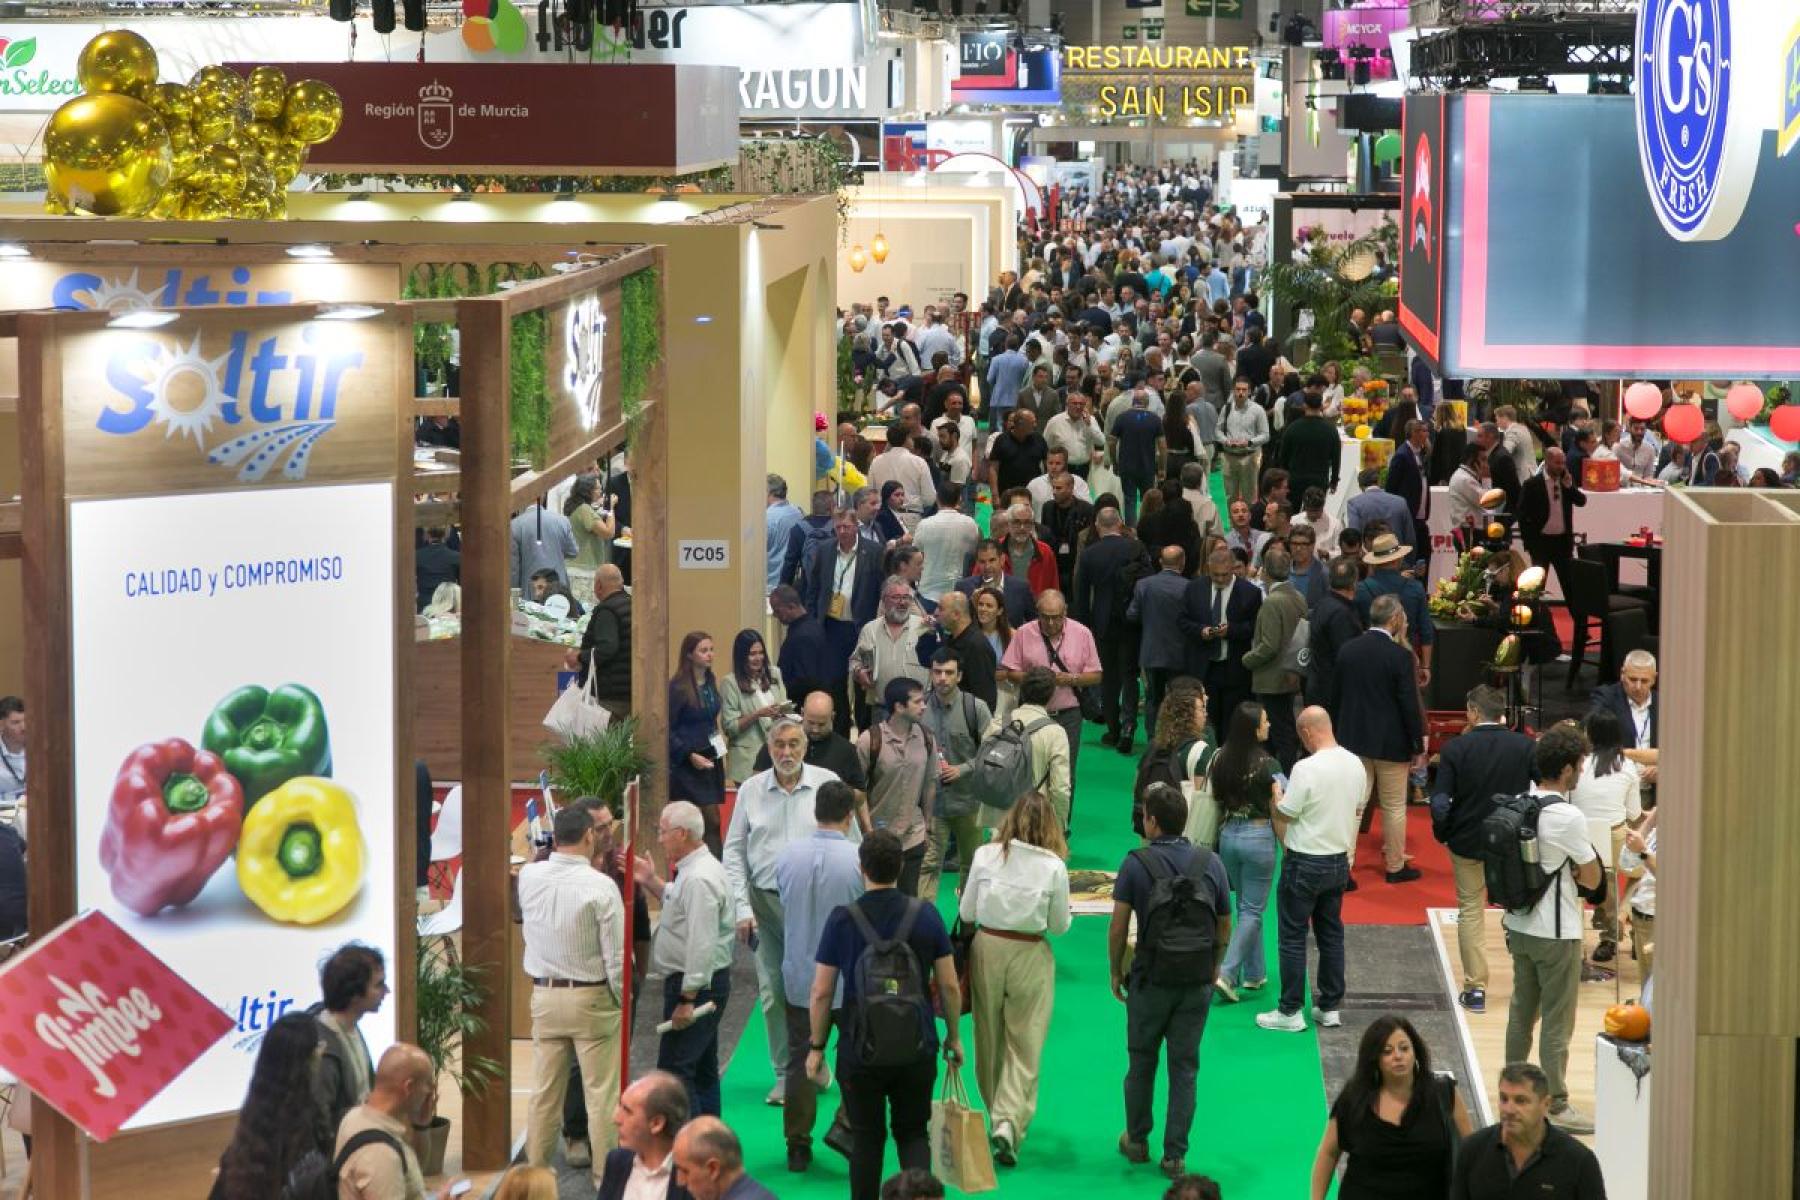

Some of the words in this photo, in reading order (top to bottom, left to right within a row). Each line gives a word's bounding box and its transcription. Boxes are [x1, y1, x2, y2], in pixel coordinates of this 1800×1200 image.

[1068, 46, 1249, 69] RESTAURANT
[1660, 1, 1711, 116] G's
[365, 103, 415, 119] Región
[458, 105, 476, 117] de
[481, 104, 529, 117] Murcia
[1101, 87, 1164, 116] SAN
[1660, 162, 1708, 213] FRESH
[683, 546, 726, 562] 7C05
[126, 567, 202, 597] CALIDAD
[208, 572, 218, 597] y
[224, 556, 343, 588] COMPROMISO
